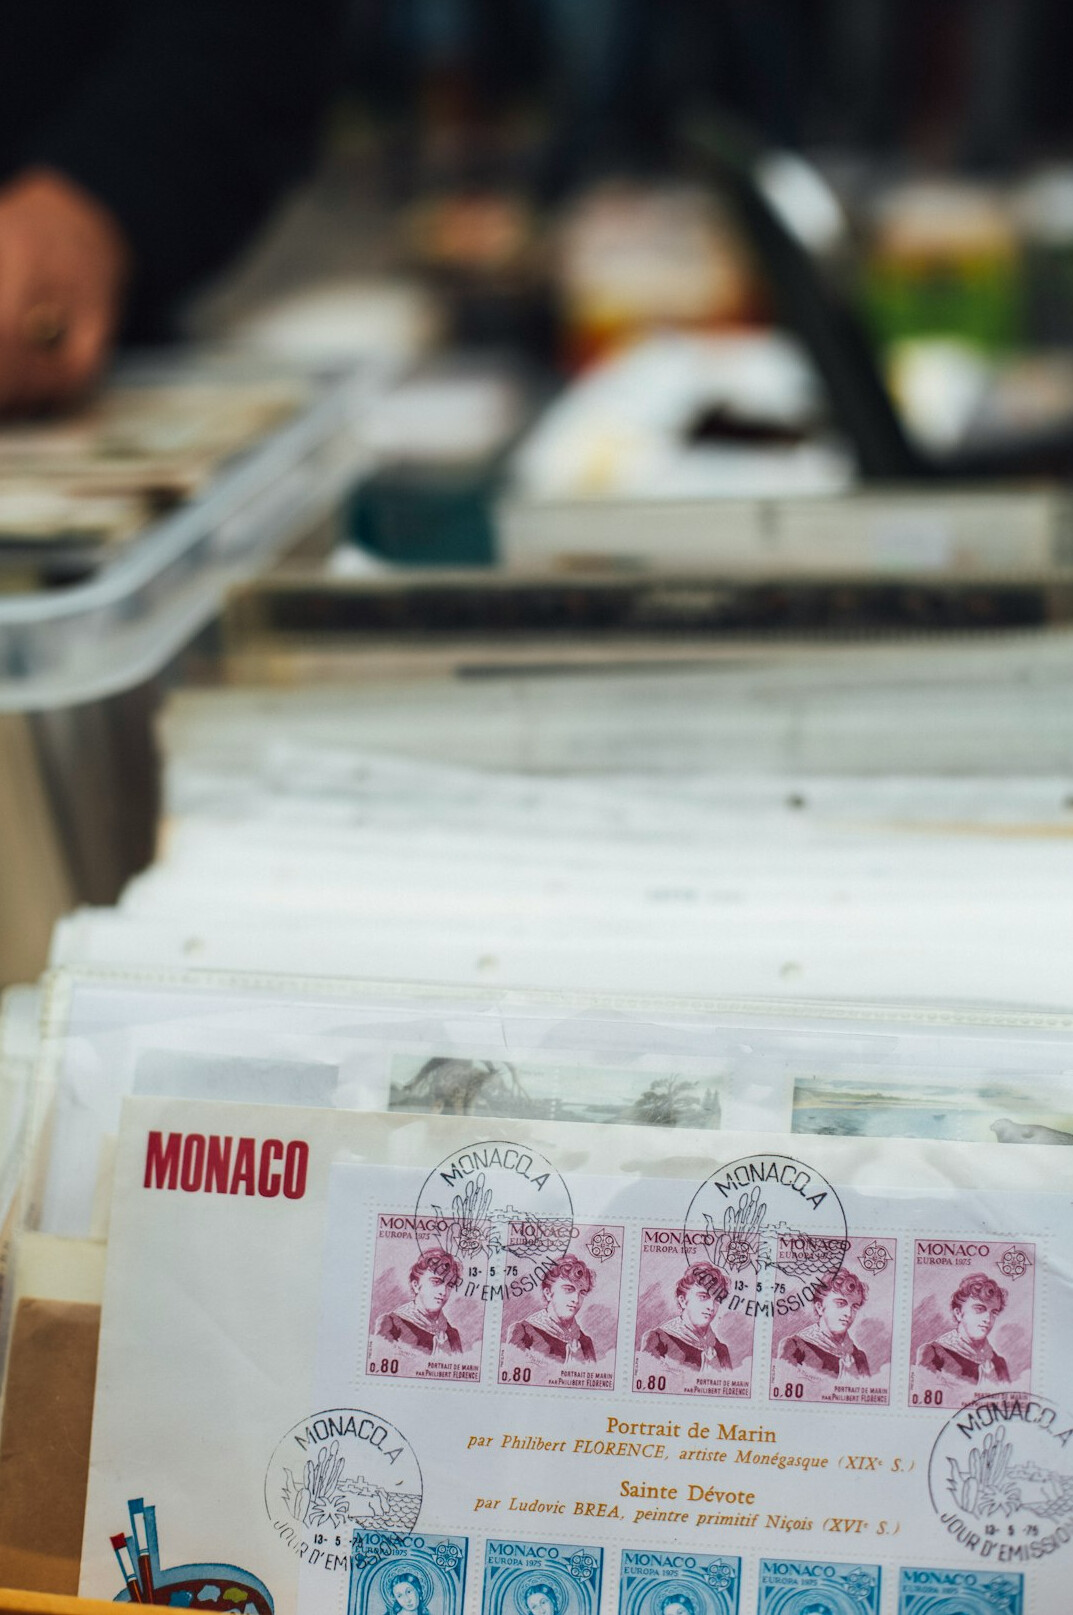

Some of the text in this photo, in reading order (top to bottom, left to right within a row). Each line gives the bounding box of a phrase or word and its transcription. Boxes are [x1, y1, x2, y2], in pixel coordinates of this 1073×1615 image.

[143, 1131, 309, 1199] MONACO
[380, 1217, 449, 1231] MONACO
[379, 1231, 412, 1240] EUROPA
[644, 1231, 715, 1245] MONACO
[643, 1245, 678, 1254] EUROPA
[917, 1243, 990, 1257] MONACO
[917, 1257, 971, 1266] EUROPA 1975
[370, 1358, 399, 1374] 0,80
[428, 1361, 452, 1370] PORTRAIT
[501, 1367, 531, 1383] 0,80
[561, 1370, 586, 1378] PORTRAIT
[595, 1372, 613, 1380] MARIN
[636, 1375, 666, 1391] 0,80
[696, 1378, 722, 1386] PORTRAIT
[773, 1382, 804, 1398] 0,80
[912, 1389, 943, 1405] 0,80
[606, 1416, 777, 1443] Portrait de Marin
[467, 1435, 493, 1450] par
[500, 1434, 567, 1452] Philibert
[573, 1439, 669, 1460] FLORENCE,
[679, 1448, 727, 1462] artiste
[734, 1449, 829, 1471] Monégasque
[620, 1480, 756, 1505] Sainte Dévote
[474, 1498, 501, 1512] par
[508, 1497, 566, 1514] Ludovic
[573, 1501, 625, 1520] BREA,
[632, 1507, 689, 1524] peintre
[696, 1512, 758, 1527] primitif
[765, 1514, 814, 1533] Niçois
[273, 1521, 308, 1558] JOUR
[940, 1512, 980, 1551] JOUR
[356, 1532, 425, 1548] MONACO
[489, 1543, 559, 1559] MONACO
[488, 1556, 542, 1567] EUROPA 1975
[625, 1552, 696, 1568] MONACO
[624, 1566, 659, 1576] EUROPA
[763, 1562, 835, 1577] MONACO
[762, 1576, 798, 1585] EUROPA
[903, 1570, 977, 1586] MONACO
